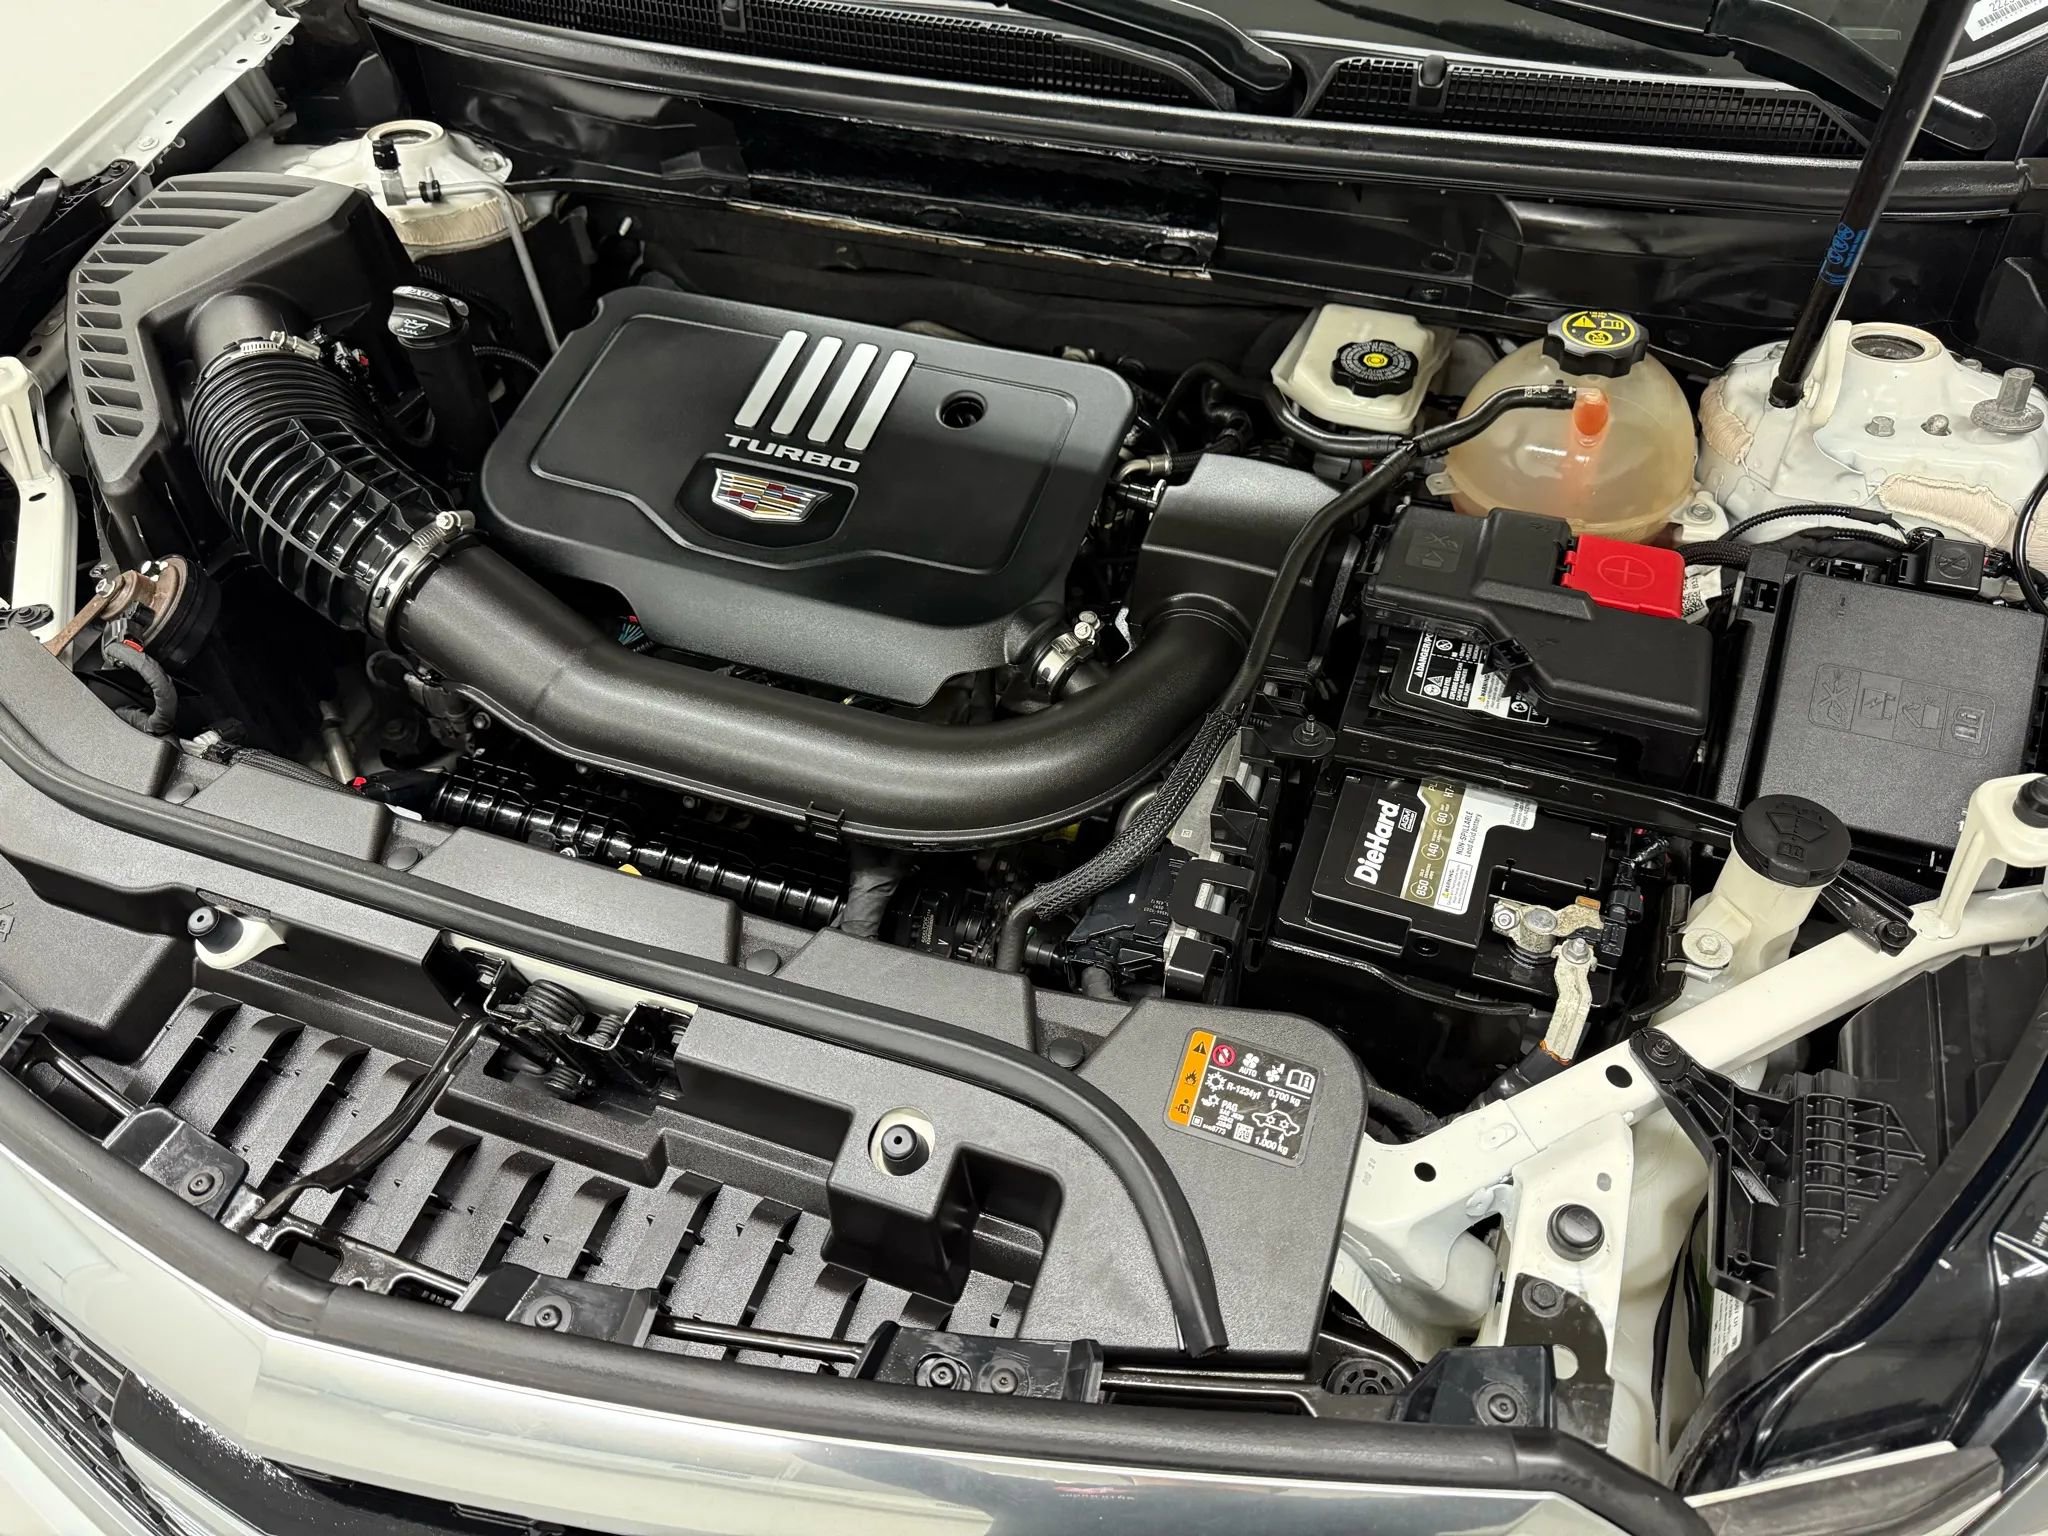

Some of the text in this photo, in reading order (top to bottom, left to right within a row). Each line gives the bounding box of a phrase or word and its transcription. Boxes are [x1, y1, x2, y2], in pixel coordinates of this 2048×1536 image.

[724, 433, 861, 473] TURBO
[1400, 809, 1411, 829] AGM
[1437, 812, 1448, 824] 80
[1455, 810, 1474, 856] NON-SPILLABLE
[1468, 831, 1476, 844] Acid
[1353, 799, 1400, 885] DieHard
[1426, 843, 1439, 857] 140
[1464, 843, 1474, 858] Lead
[1416, 879, 1429, 896] 850
[1239, 1066, 1257, 1077] AUTO
[1226, 1082, 1262, 1100] R-1234yf
[1267, 1088, 1301, 1107] 0.700 kg
[1221, 1100, 1239, 1112] PAG
[1254, 1136, 1289, 1155] 1.000 kg
